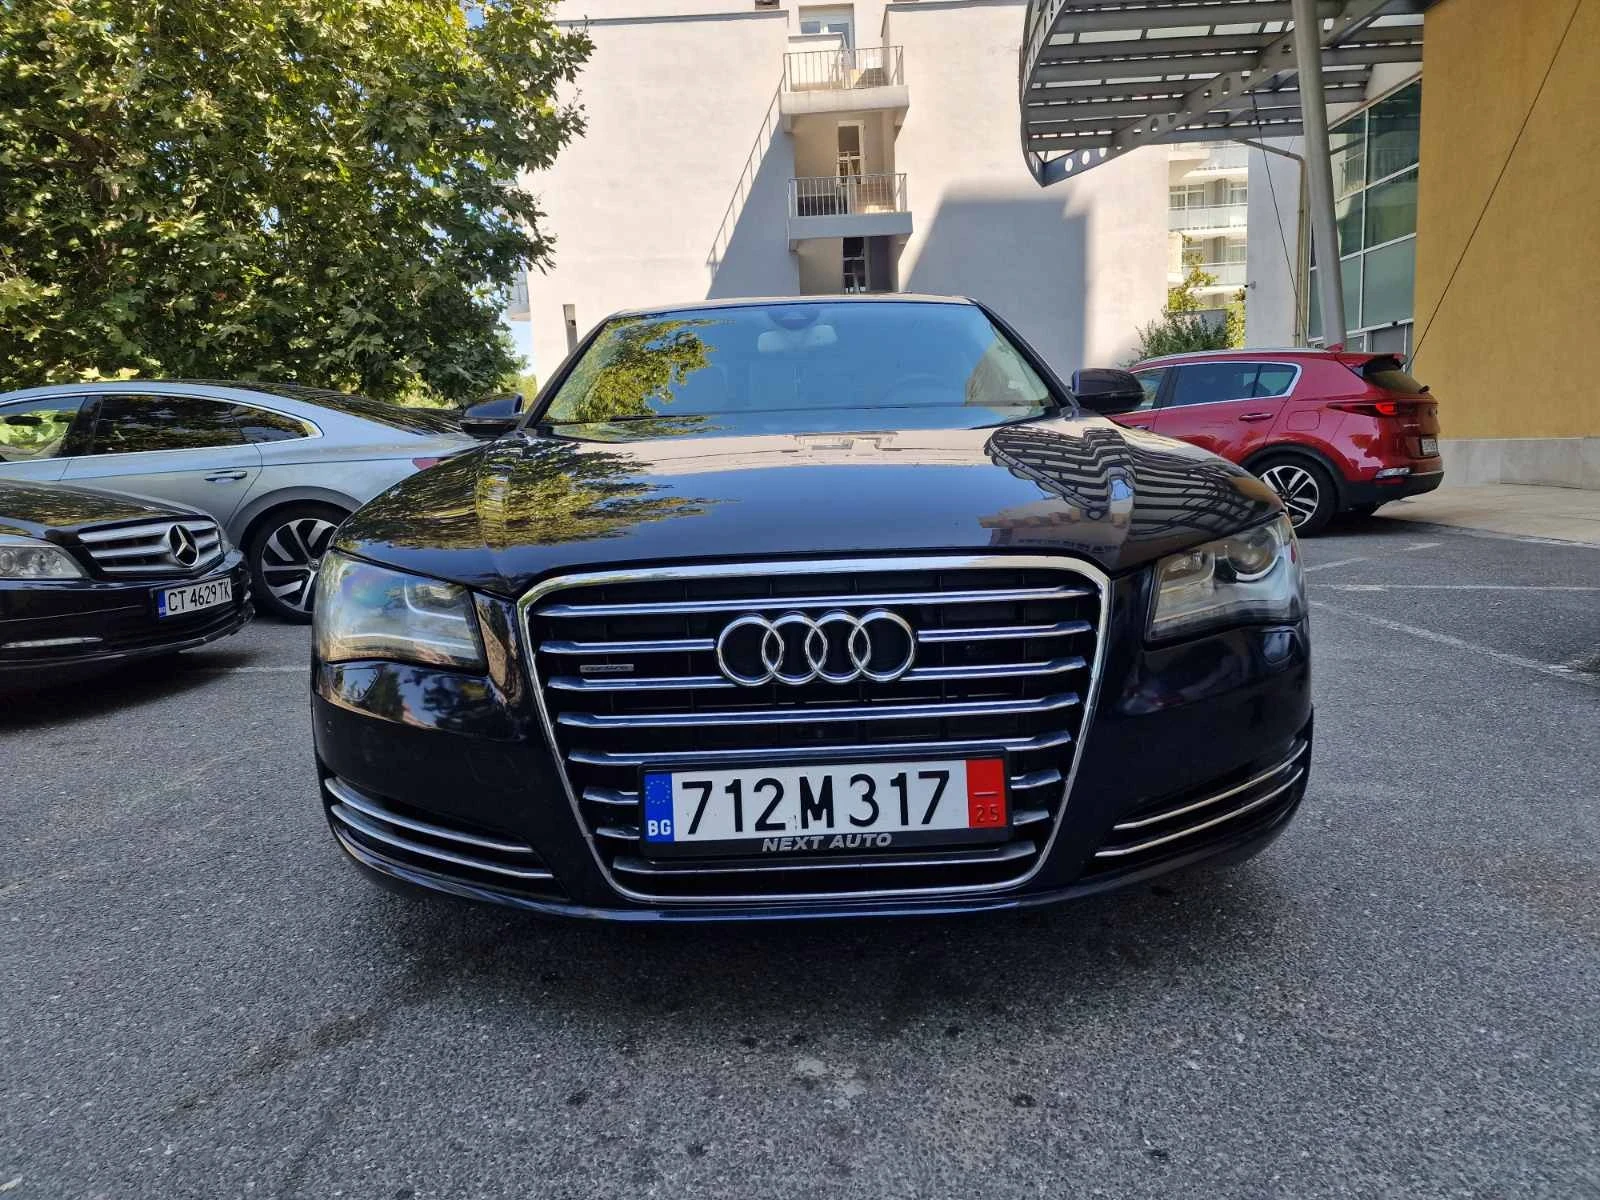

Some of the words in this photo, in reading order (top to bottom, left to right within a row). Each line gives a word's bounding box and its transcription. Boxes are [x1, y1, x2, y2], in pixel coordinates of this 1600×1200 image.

[168, 590, 186, 611] CT
[190, 584, 217, 606] 4629
[218, 582, 231, 601] TK
[976, 804, 1000, 823] 25
[648, 819, 671, 836] BG
[761, 836, 825, 852] NEXT
[828, 833, 893, 849] AUTO
